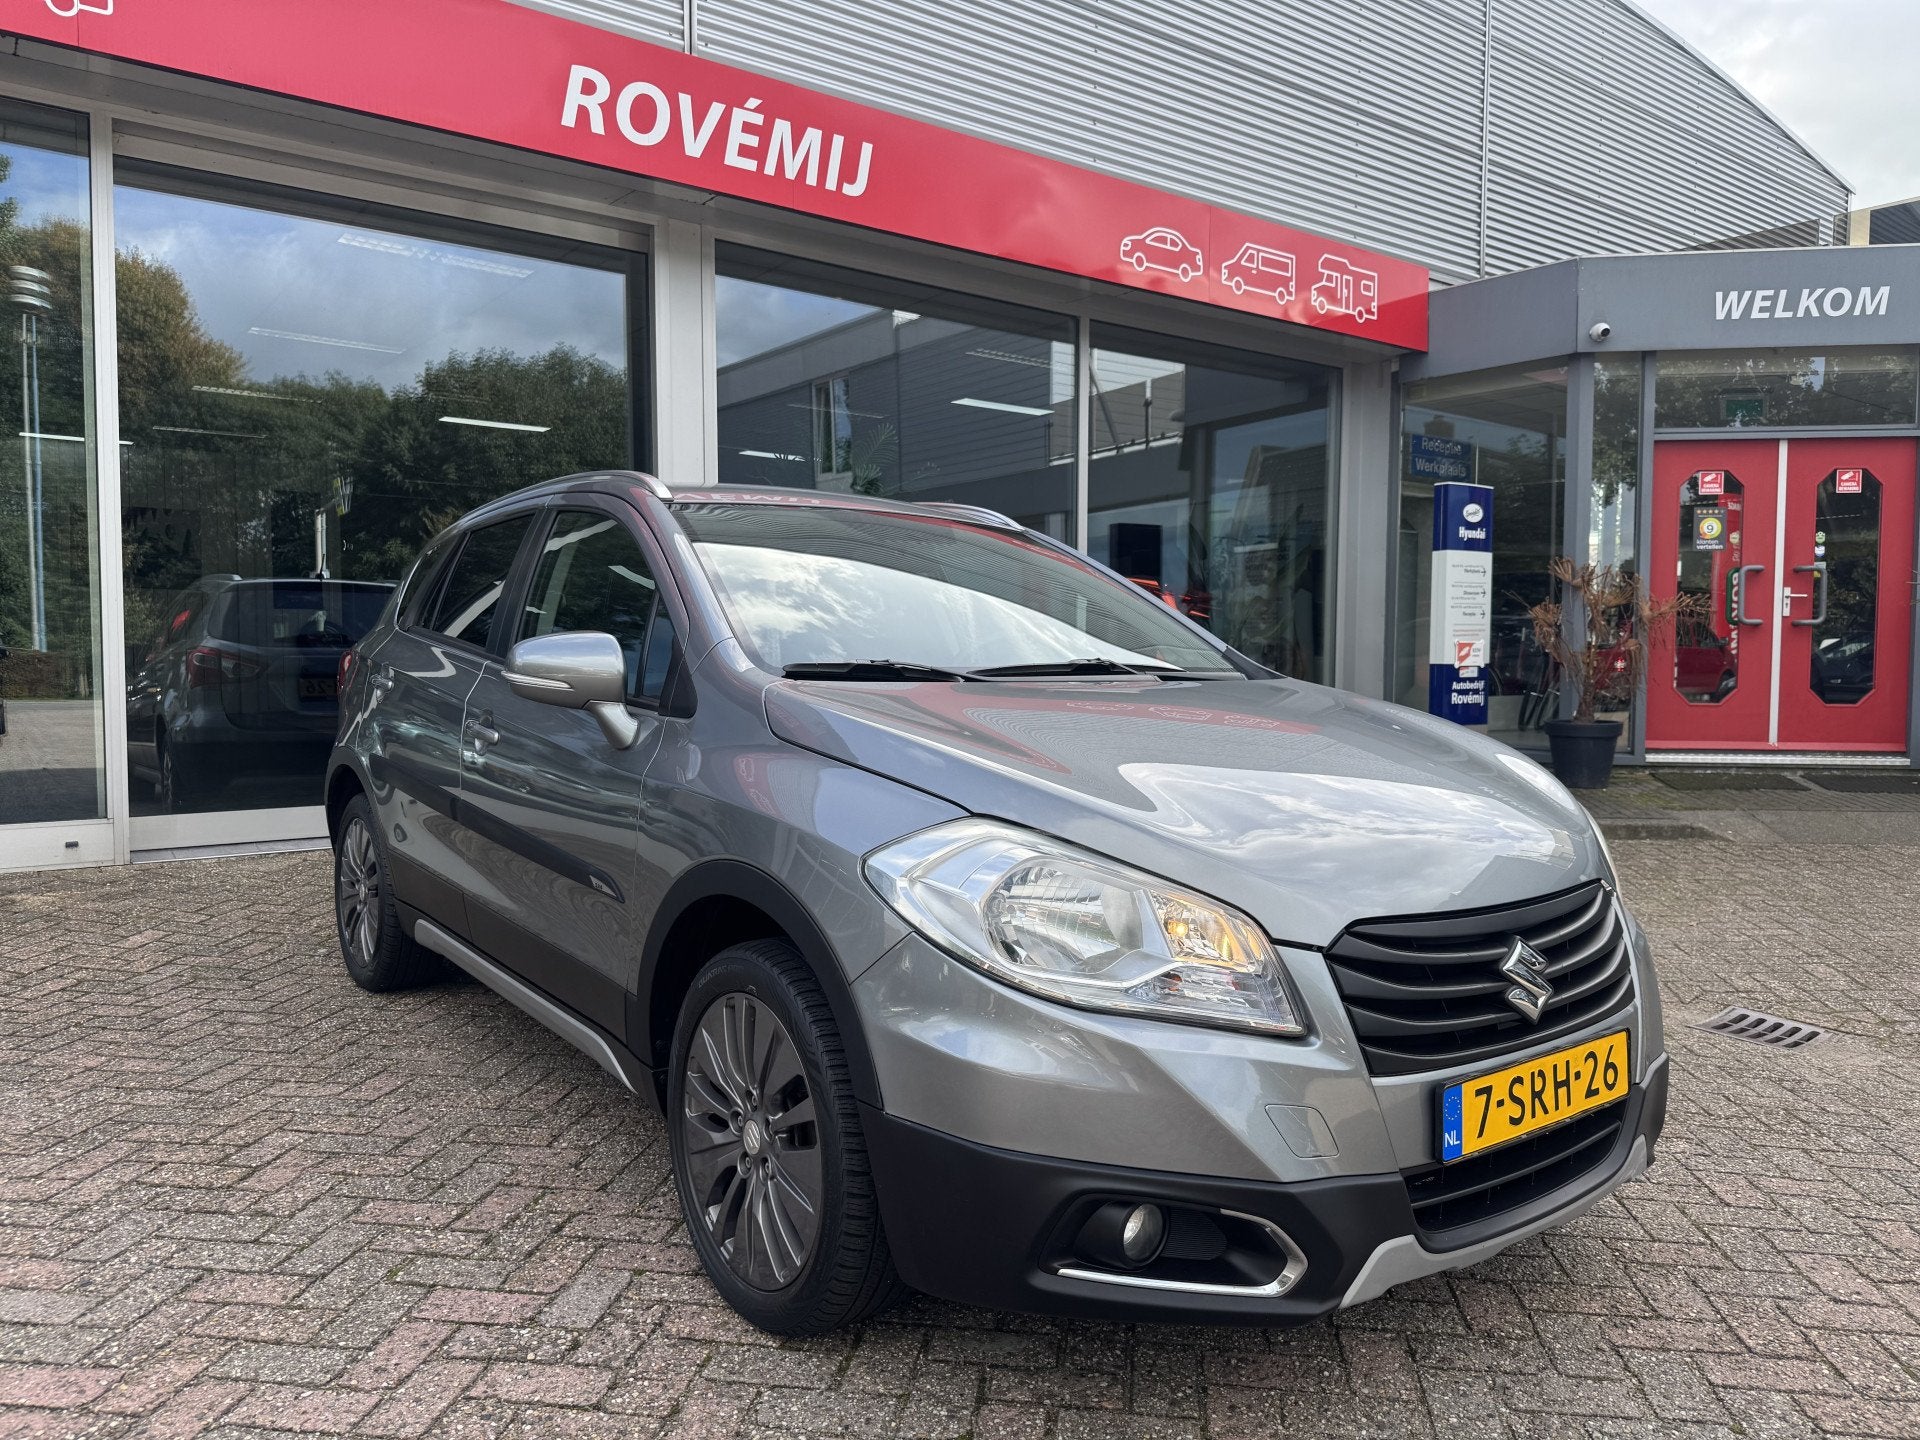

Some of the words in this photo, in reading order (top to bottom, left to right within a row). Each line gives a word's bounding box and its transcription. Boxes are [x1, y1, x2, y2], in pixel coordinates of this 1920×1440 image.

[561, 64, 873, 197] ROVÉMIJ
[1715, 285, 1890, 320] WELKOM
[1421, 437, 1462, 456] Receptie
[1415, 457, 1467, 478] Werkplaats
[1458, 526, 1486, 541] Hyundai
[1706, 524, 1714, 534] 9
[1451, 680, 1485, 691] Autobedrijf
[1451, 691, 1485, 707] Rovémij
[1474, 1044, 1619, 1139] 7-SRH-26
[1444, 1130, 1460, 1148] NL
